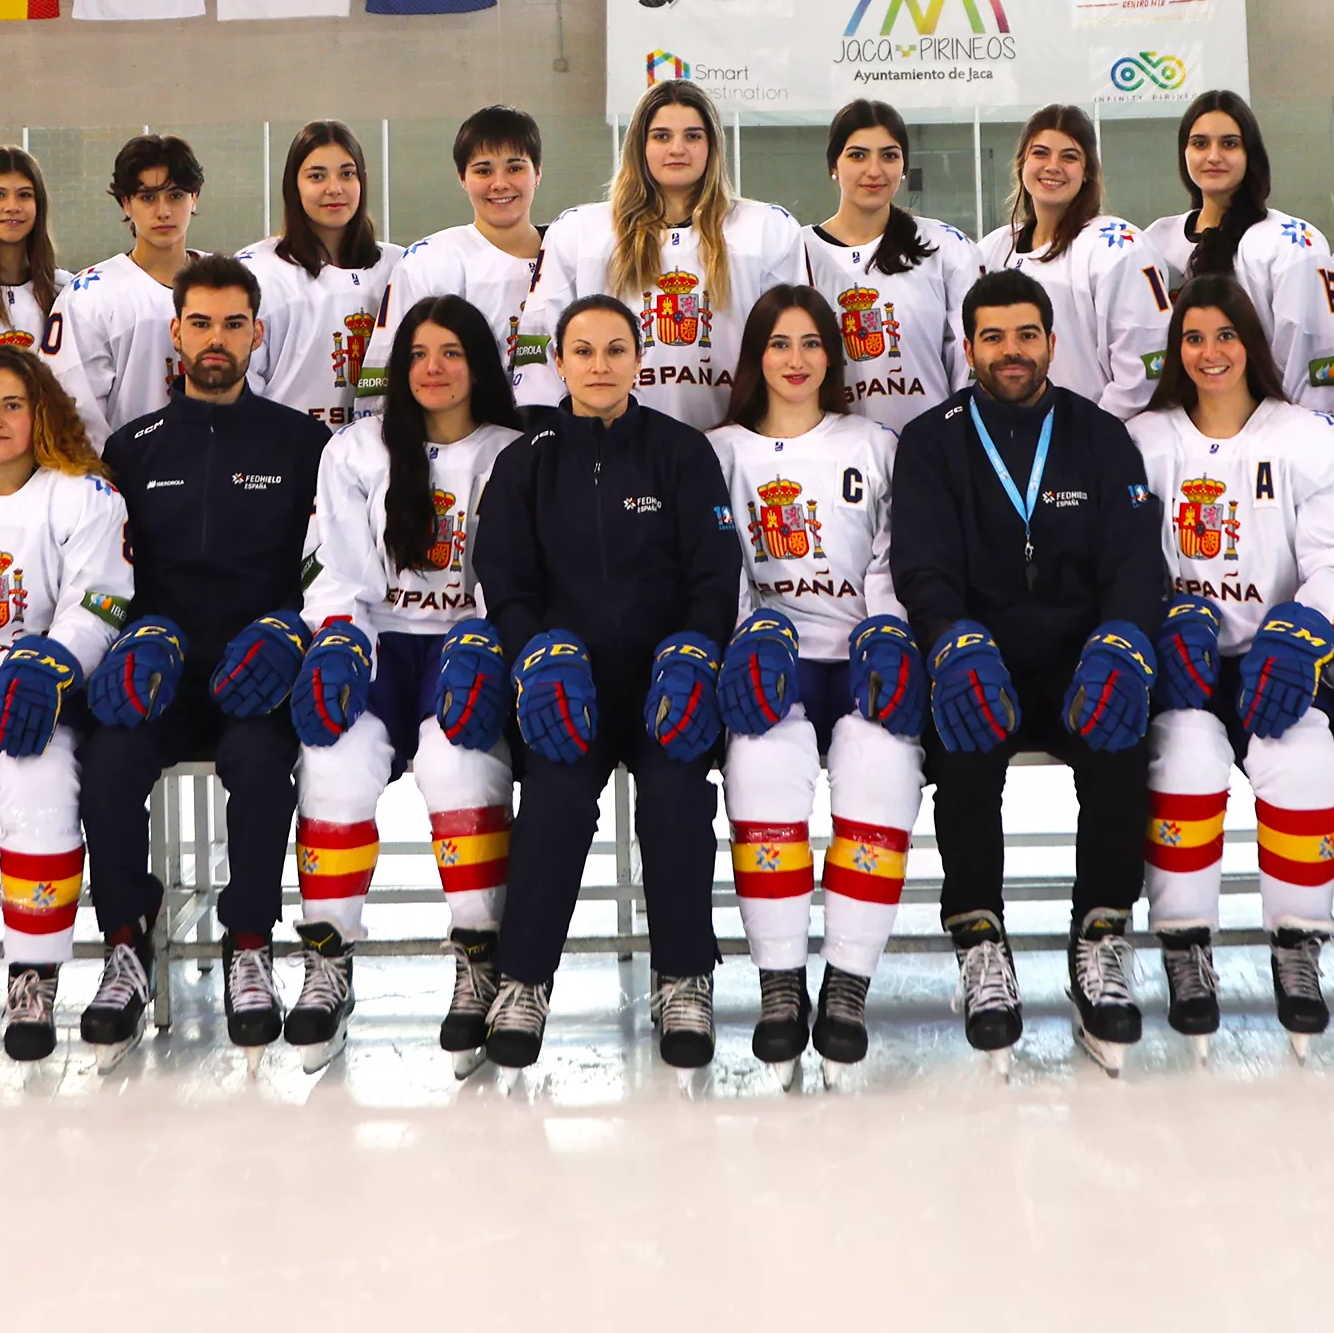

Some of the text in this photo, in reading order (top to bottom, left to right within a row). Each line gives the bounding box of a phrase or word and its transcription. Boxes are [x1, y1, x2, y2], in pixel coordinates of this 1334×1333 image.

[920, 36, 1017, 60] PIRINEOS
[695, 63, 749, 81] Smart
[854, 67, 993, 84] Ayuntamiento de Jaca
[708, 86, 788, 101] estination
[1152, 93, 1199, 101] PIRINEO
[633, 356, 734, 387] SPAÑA
[844, 366, 926, 403] SPAÑA
[134, 419, 164, 439] CCM
[245, 474, 282, 484] FEDHIELO
[842, 466, 863, 504] C
[1256, 461, 1275, 500] A
[1175, 570, 1264, 604] SPAÑA
